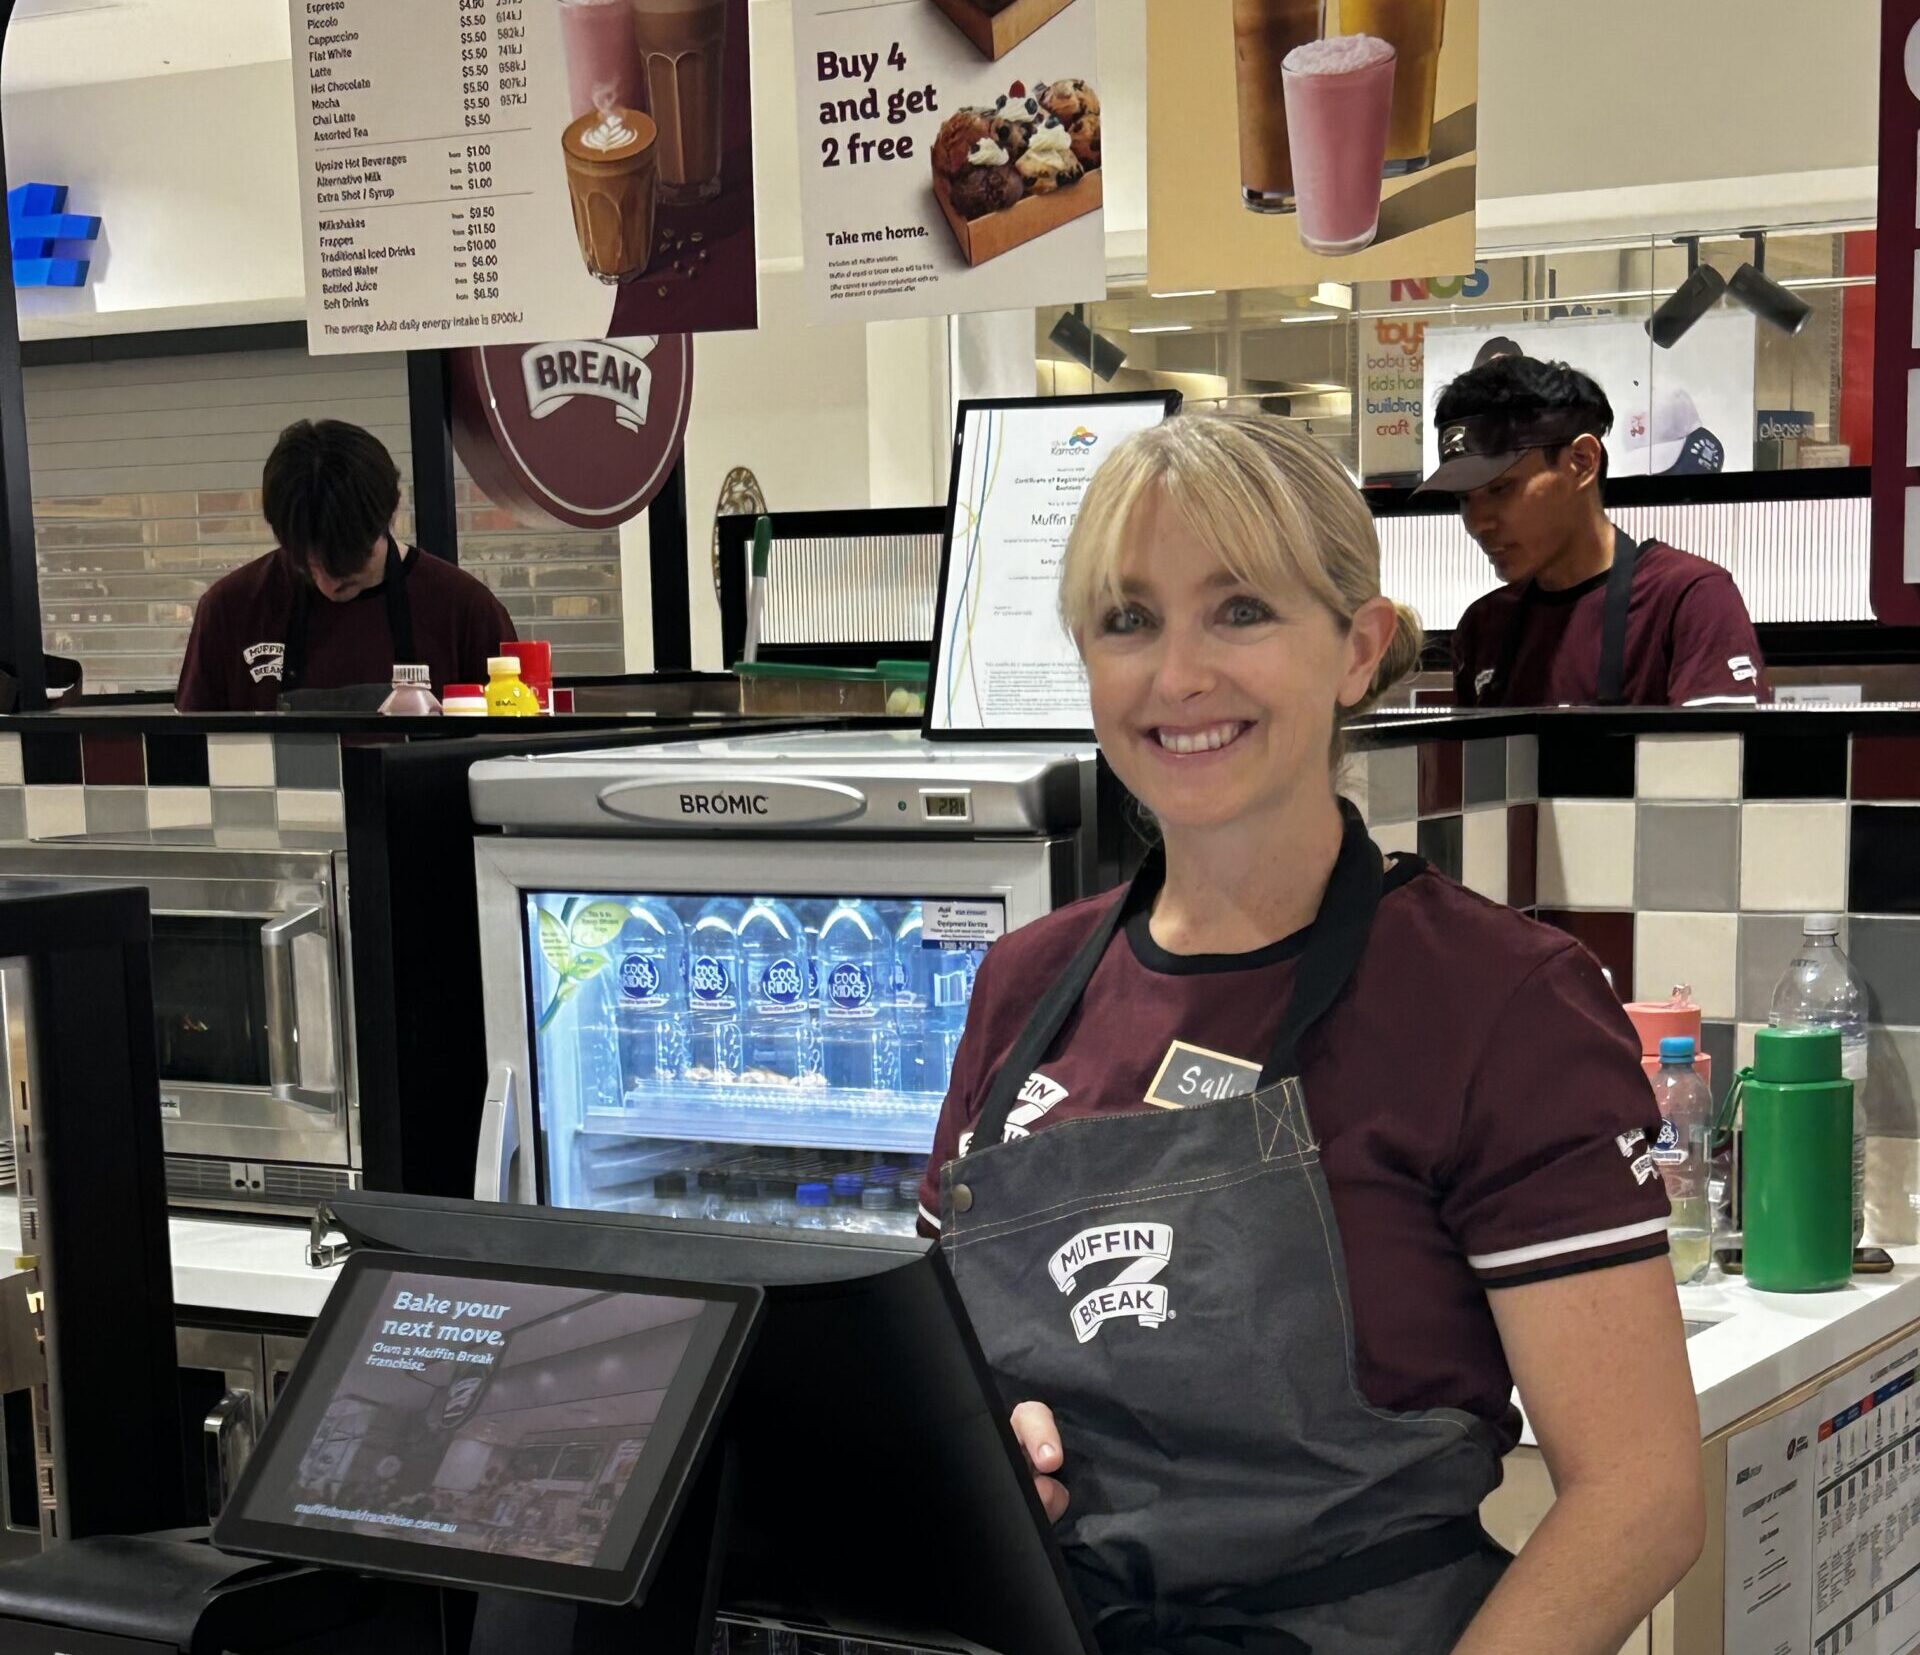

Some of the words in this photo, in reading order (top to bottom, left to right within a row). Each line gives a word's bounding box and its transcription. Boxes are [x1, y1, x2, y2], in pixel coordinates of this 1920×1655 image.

[306, 1, 345, 14] Espresso
[307, 17, 339, 30] Piccolo
[460, 14, 486, 28] $5.50
[496, 9, 522, 23] 614kJ
[308, 31, 359, 47] Cappuccino
[461, 31, 487, 44] $5.50
[309, 51, 326, 62] Flat
[327, 49, 352, 60] White
[462, 47, 488, 61] $5.50
[498, 43, 523, 57] 741kJ
[817, 51, 879, 82] Buy
[887, 42, 907, 71] 4
[310, 68, 332, 78] Latte
[462, 64, 489, 78] $5.50
[311, 83, 326, 94] Hot
[327, 79, 371, 92] Chocolate
[463, 81, 489, 94] $5.50
[312, 98, 340, 110] Mocha
[464, 97, 490, 111] $5.50
[819, 88, 880, 124] and
[887, 84, 938, 124] get
[312, 114, 332, 126] Chai
[334, 113, 356, 124] Latte
[464, 113, 491, 127] $5.50
[314, 128, 351, 142] Assorted
[353, 127, 369, 138] Tea
[467, 144, 491, 157] $1.00
[821, 137, 840, 168] 2
[847, 133, 913, 165] free
[315, 160, 343, 174] Upsize
[345, 158, 360, 169] Hot
[362, 155, 407, 168] Beverages
[467, 161, 492, 174] $1.00
[317, 175, 362, 188] Alternative
[364, 171, 382, 183] Milk
[468, 177, 493, 190] $1.00
[317, 192, 339, 203] Extra
[341, 190, 361, 201] Shot
[369, 187, 395, 201] Syrup
[319, 218, 366, 231] Milkshakes
[468, 223, 495, 236] $11.50
[319, 237, 354, 248] Frappes
[826, 232, 859, 246] Take
[861, 231, 883, 243] me
[885, 225, 929, 240] home.
[467, 239, 496, 252] $10.00
[321, 249, 366, 263] Traditional
[368, 247, 387, 259] Iced
[388, 245, 416, 258] Drinks
[321, 266, 352, 278] Bottled
[354, 265, 379, 276] Water
[322, 282, 353, 294] Bottled
[355, 282, 379, 293] Juice
[323, 299, 341, 310] Soft
[342, 297, 369, 308] Drinks
[325, 325, 340, 334] The
[341, 325, 374, 335] average
[376, 320, 397, 332] Adult
[399, 319, 420, 331] daily
[422, 319, 451, 330] energy
[453, 316, 479, 327] intake
[481, 315, 489, 325] is
[491, 312, 524, 325] 8700kJ
[1367, 353, 1405, 371] baby
[535, 350, 642, 400] BREAK
[1367, 373, 1395, 392] kids
[1366, 397, 1422, 417] building
[1376, 419, 1411, 436] craft
[1031, 513, 1067, 526] Muffin
[680, 794, 769, 814] BROMIC
[770, 968, 800, 981] COOL
[834, 972, 865, 985] COOL
[768, 980, 801, 994] RIDGE
[832, 985, 867, 998] RIDGE
[1060, 1230, 1154, 1272] MUFFIN
[393, 1291, 452, 1314] Bake
[451, 1300, 512, 1320] your
[1079, 1290, 1154, 1325] BREAK
[381, 1319, 435, 1338] next
[437, 1325, 506, 1346] move.
[372, 1342, 402, 1354] Own
[404, 1347, 412, 1355] a
[412, 1346, 456, 1361] Muffin
[456, 1351, 495, 1365] Break
[294, 1503, 459, 1533] muffinbreakfranchise.com.au
